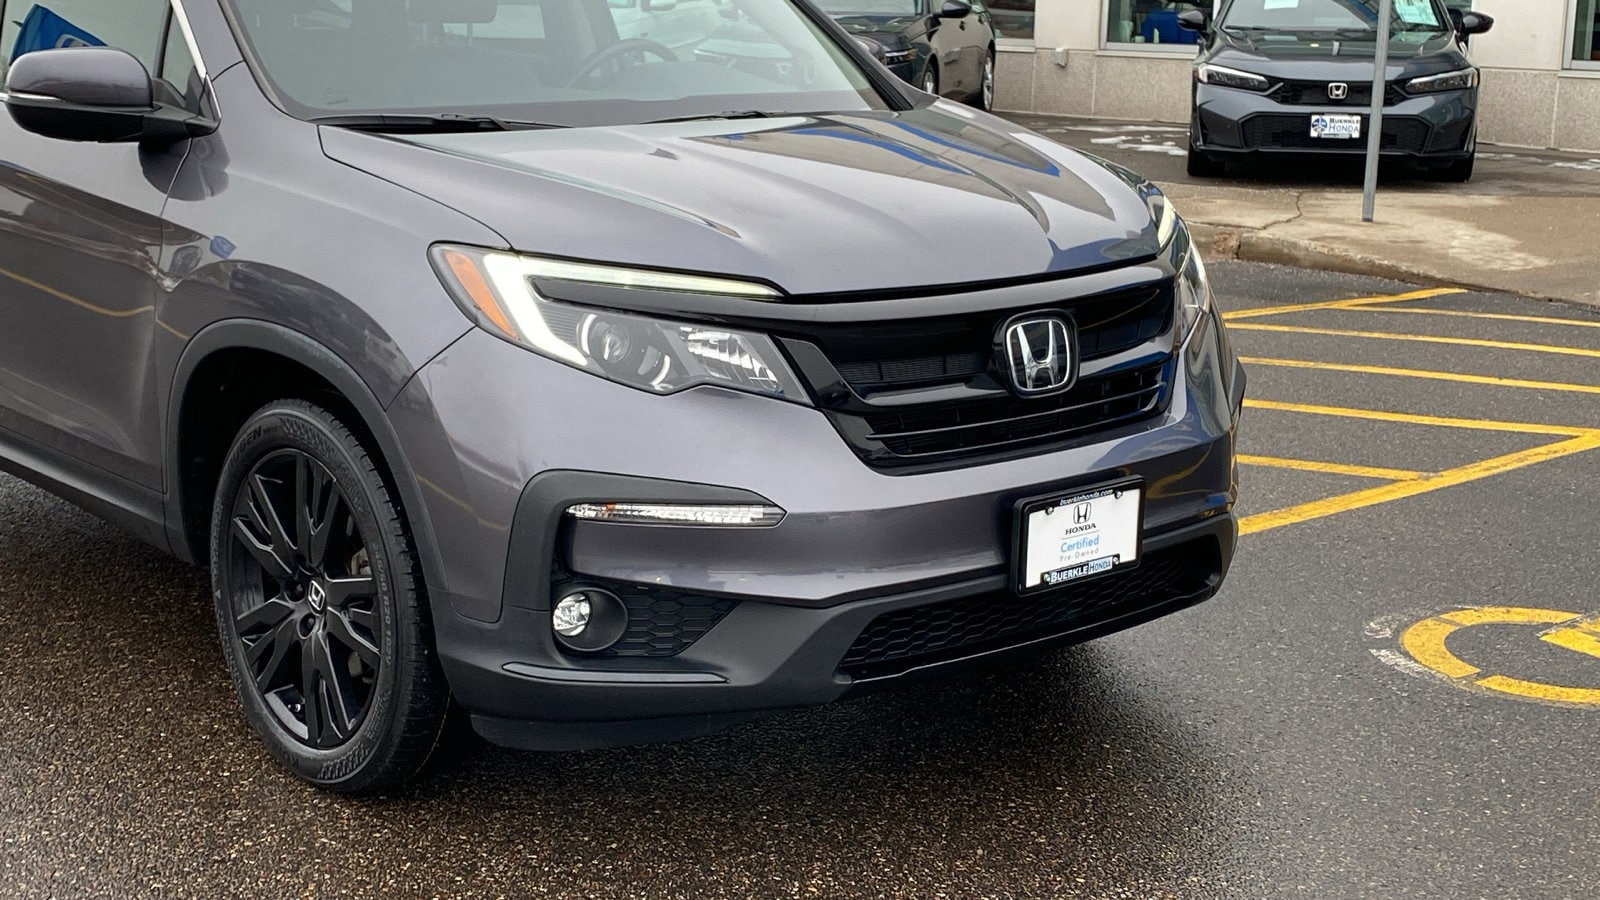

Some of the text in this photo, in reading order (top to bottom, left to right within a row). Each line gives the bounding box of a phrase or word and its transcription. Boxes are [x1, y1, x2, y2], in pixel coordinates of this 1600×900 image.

[1329, 124, 1360, 133] HONDA
[1065, 523, 1097, 535] HONDA
[1060, 534, 1100, 553] Certified
[1050, 560, 1112, 583] BUERKLE HONDA
